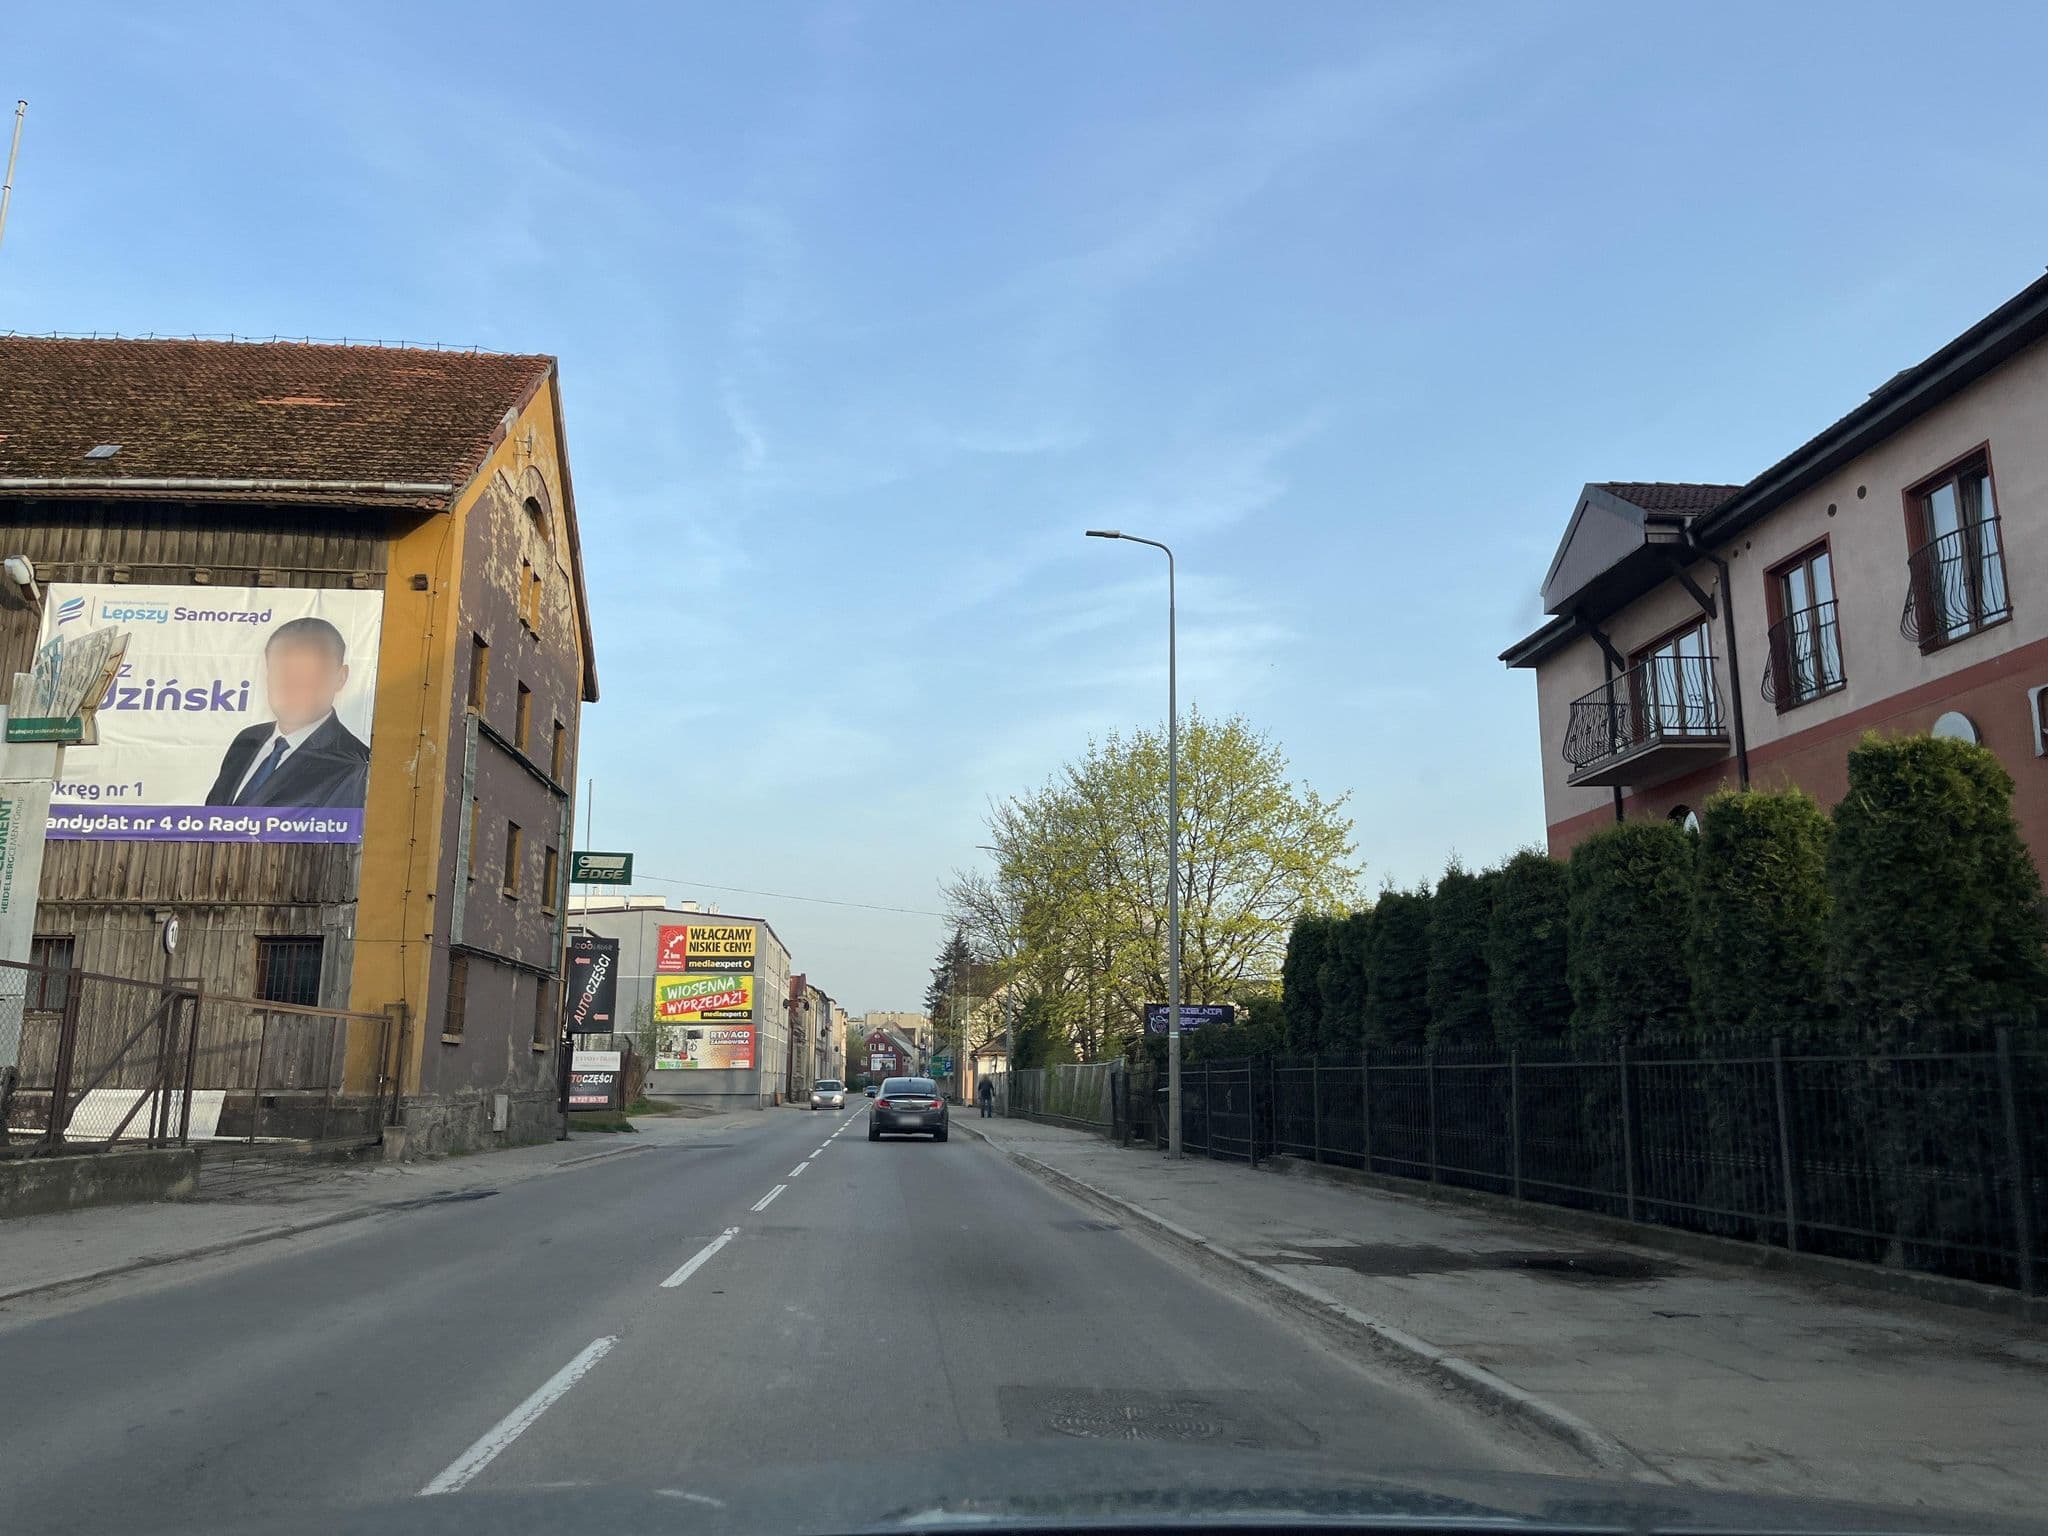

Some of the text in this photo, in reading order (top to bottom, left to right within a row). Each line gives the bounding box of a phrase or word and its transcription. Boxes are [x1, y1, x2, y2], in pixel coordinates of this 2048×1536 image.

[102, 606, 272, 626] Lepszy Samorząd
[100, 678, 250, 712] dziński
[51, 781, 143, 800] kręg nr 1
[46, 814, 348, 835] andydat nr 4 do Rady Powiatu
[576, 869, 625, 880] EDGE
[663, 950, 670, 959] 2
[689, 942, 752, 953] NISKIE CENY!
[688, 959, 743, 969] mediaexpert
[573, 953, 611, 1025] AUTOCZĘŚCI
[666, 976, 736, 1000] WIOSENNA
[666, 991, 742, 1014] WYPRZEDAŻ!
[570, 1072, 614, 1086] TOCZĘŚCI
